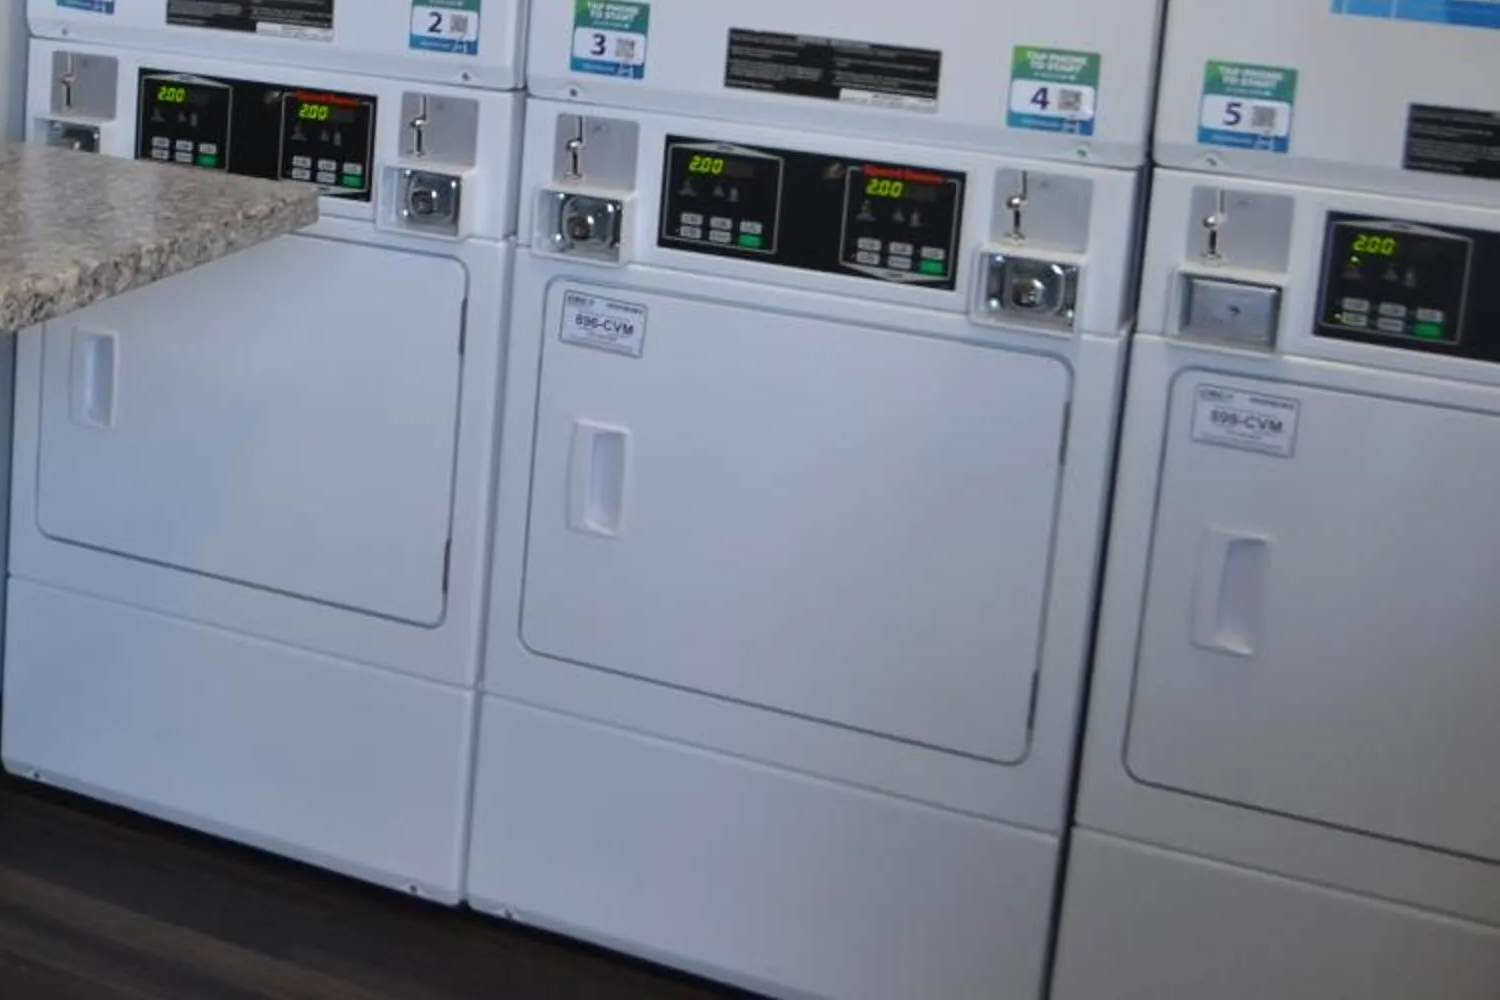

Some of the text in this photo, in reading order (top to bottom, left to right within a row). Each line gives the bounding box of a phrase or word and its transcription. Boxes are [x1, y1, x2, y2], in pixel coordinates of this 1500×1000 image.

[427, 11, 443, 34] 2
[591, 33, 607, 56] 3
[1030, 86, 1050, 110] 4
[1222, 101, 1243, 126] 5
